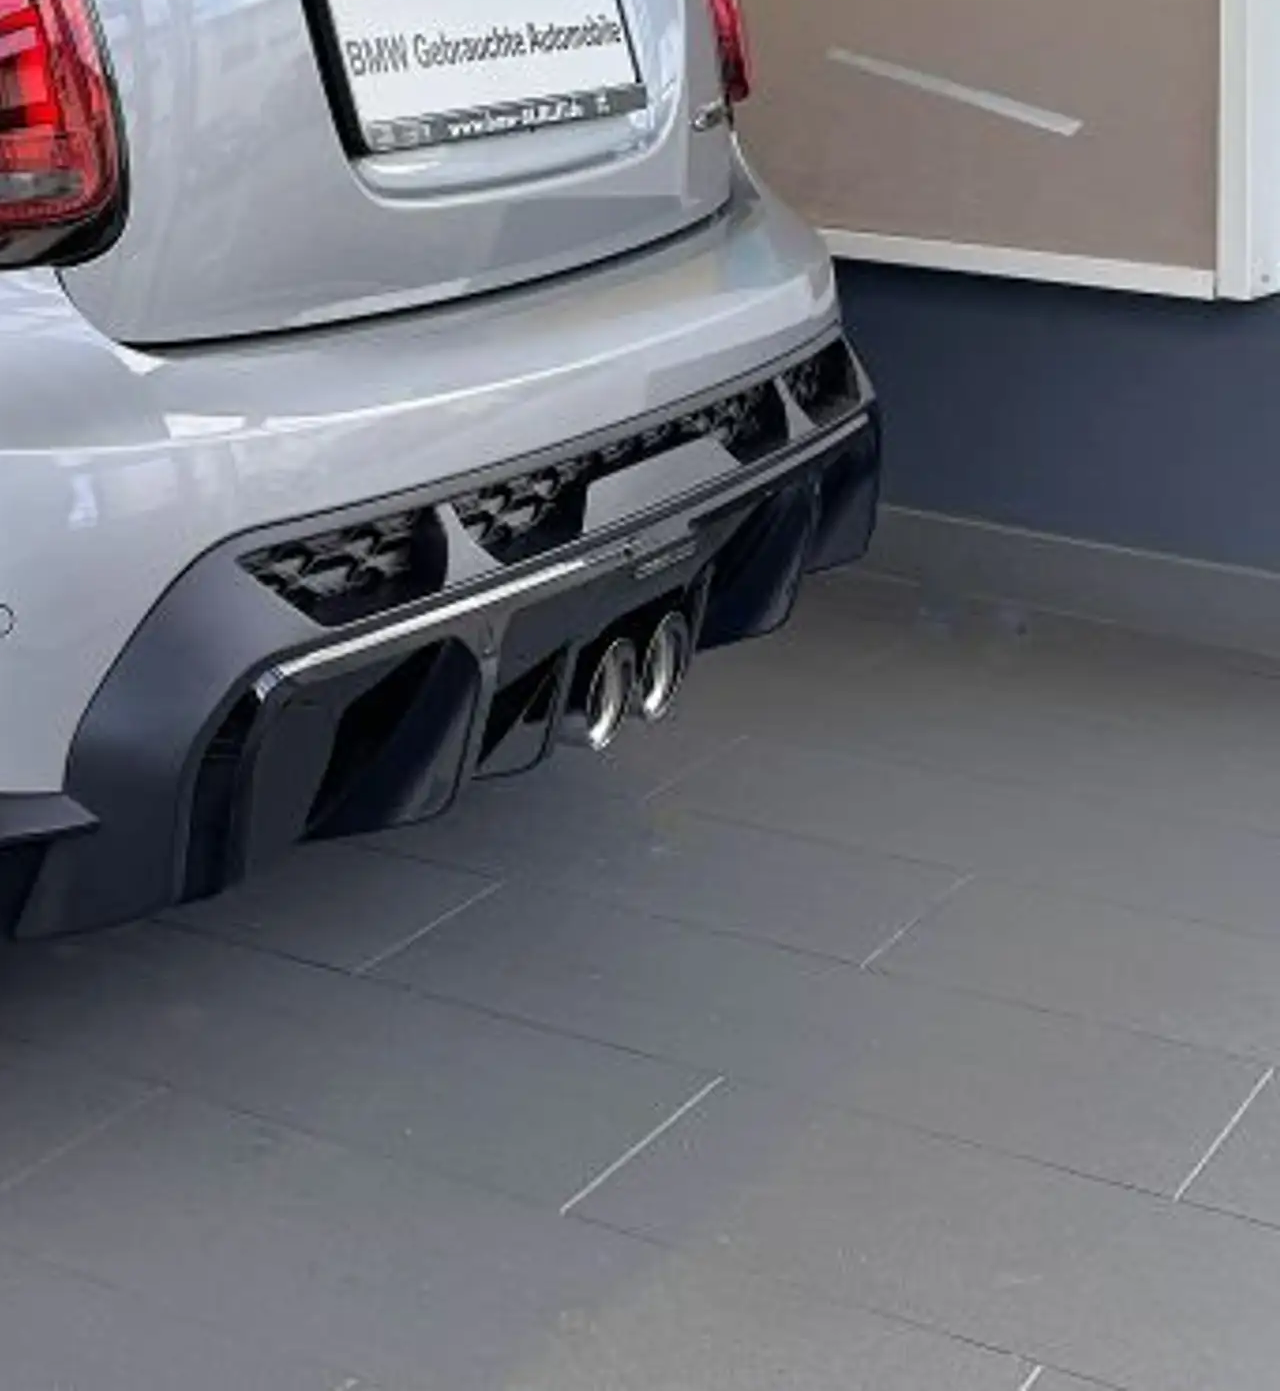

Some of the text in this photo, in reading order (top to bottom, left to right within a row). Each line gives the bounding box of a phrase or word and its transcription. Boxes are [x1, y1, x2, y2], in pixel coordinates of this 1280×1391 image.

[346, 13, 622, 76] BMW Gebrauchte Automobile
